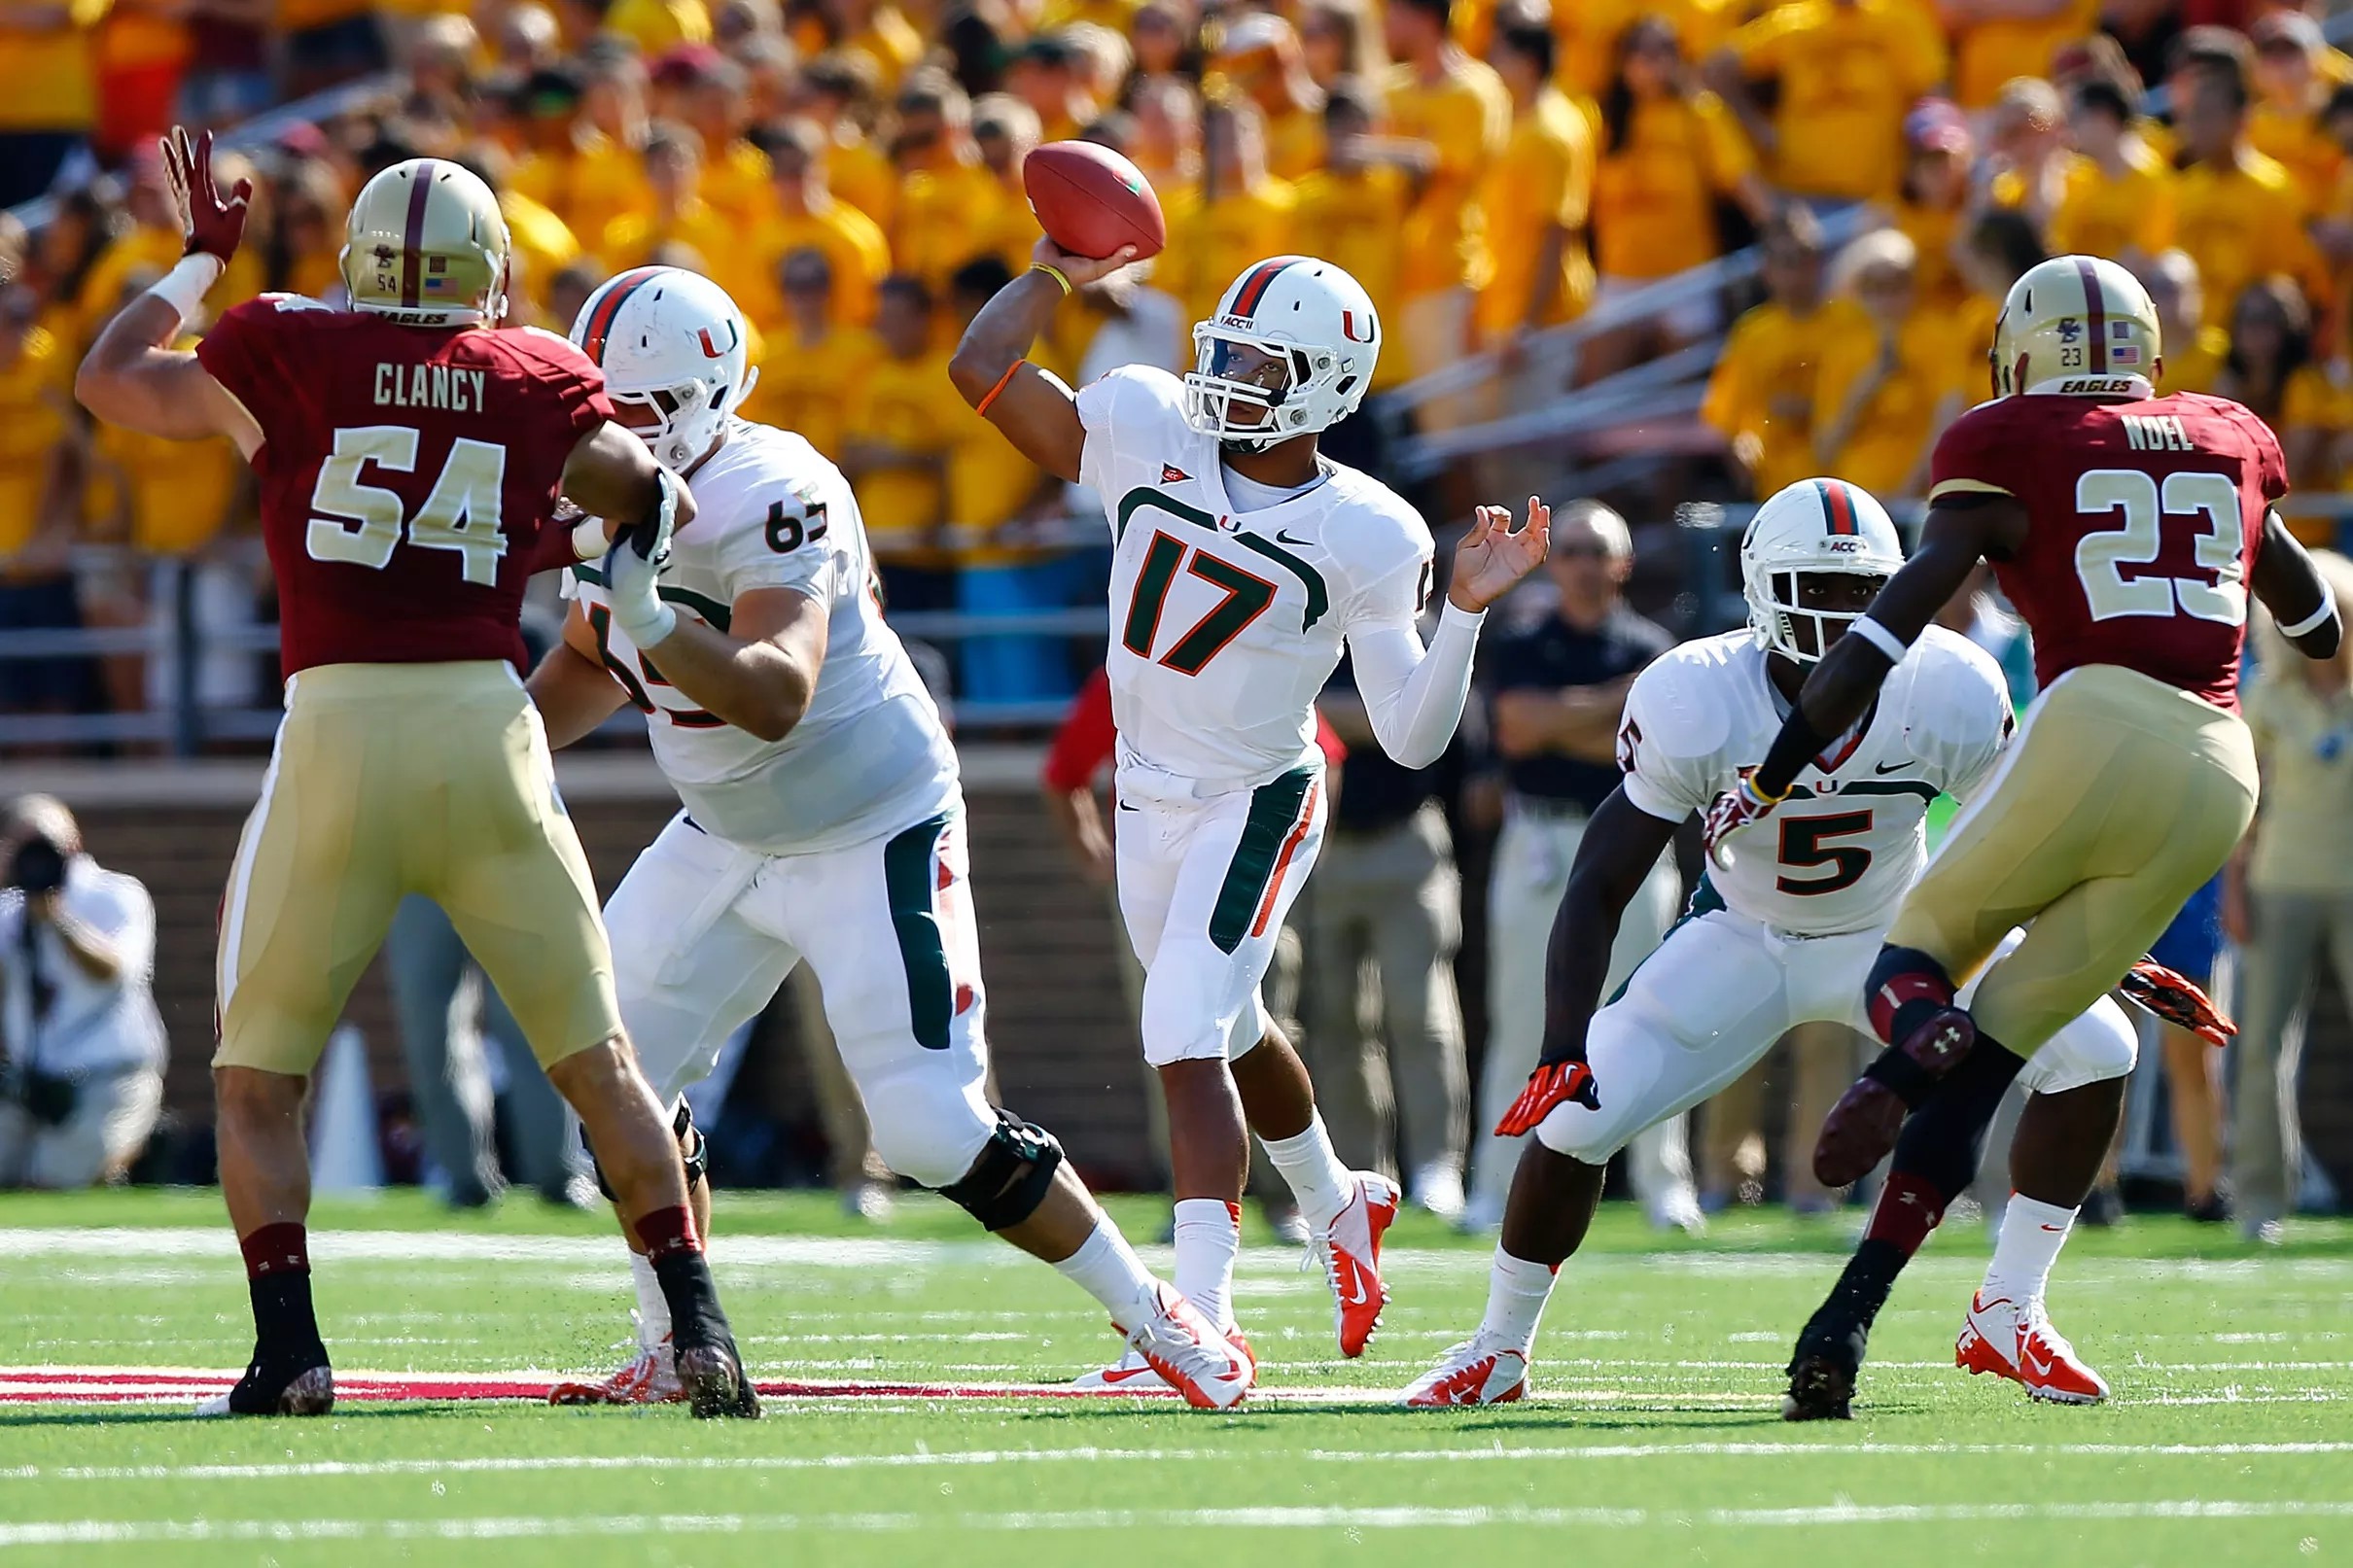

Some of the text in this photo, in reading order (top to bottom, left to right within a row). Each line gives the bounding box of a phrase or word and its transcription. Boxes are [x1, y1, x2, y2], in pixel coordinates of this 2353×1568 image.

[377, 273, 398, 294] 54
[696, 318, 738, 359] U
[1342, 310, 1375, 343] U
[2061, 347, 2082, 366] 23
[374, 363, 485, 413] CLANCY
[2059, 380, 2132, 394] EAGLES
[305, 425, 509, 588] 54
[1218, 514, 1243, 534] U
[1829, 541, 1857, 553] ACC
[2074, 468, 2248, 627] 23
[1122, 528, 1279, 678] 17
[1815, 779, 1838, 794] U
[1775, 808, 1875, 896] 5
